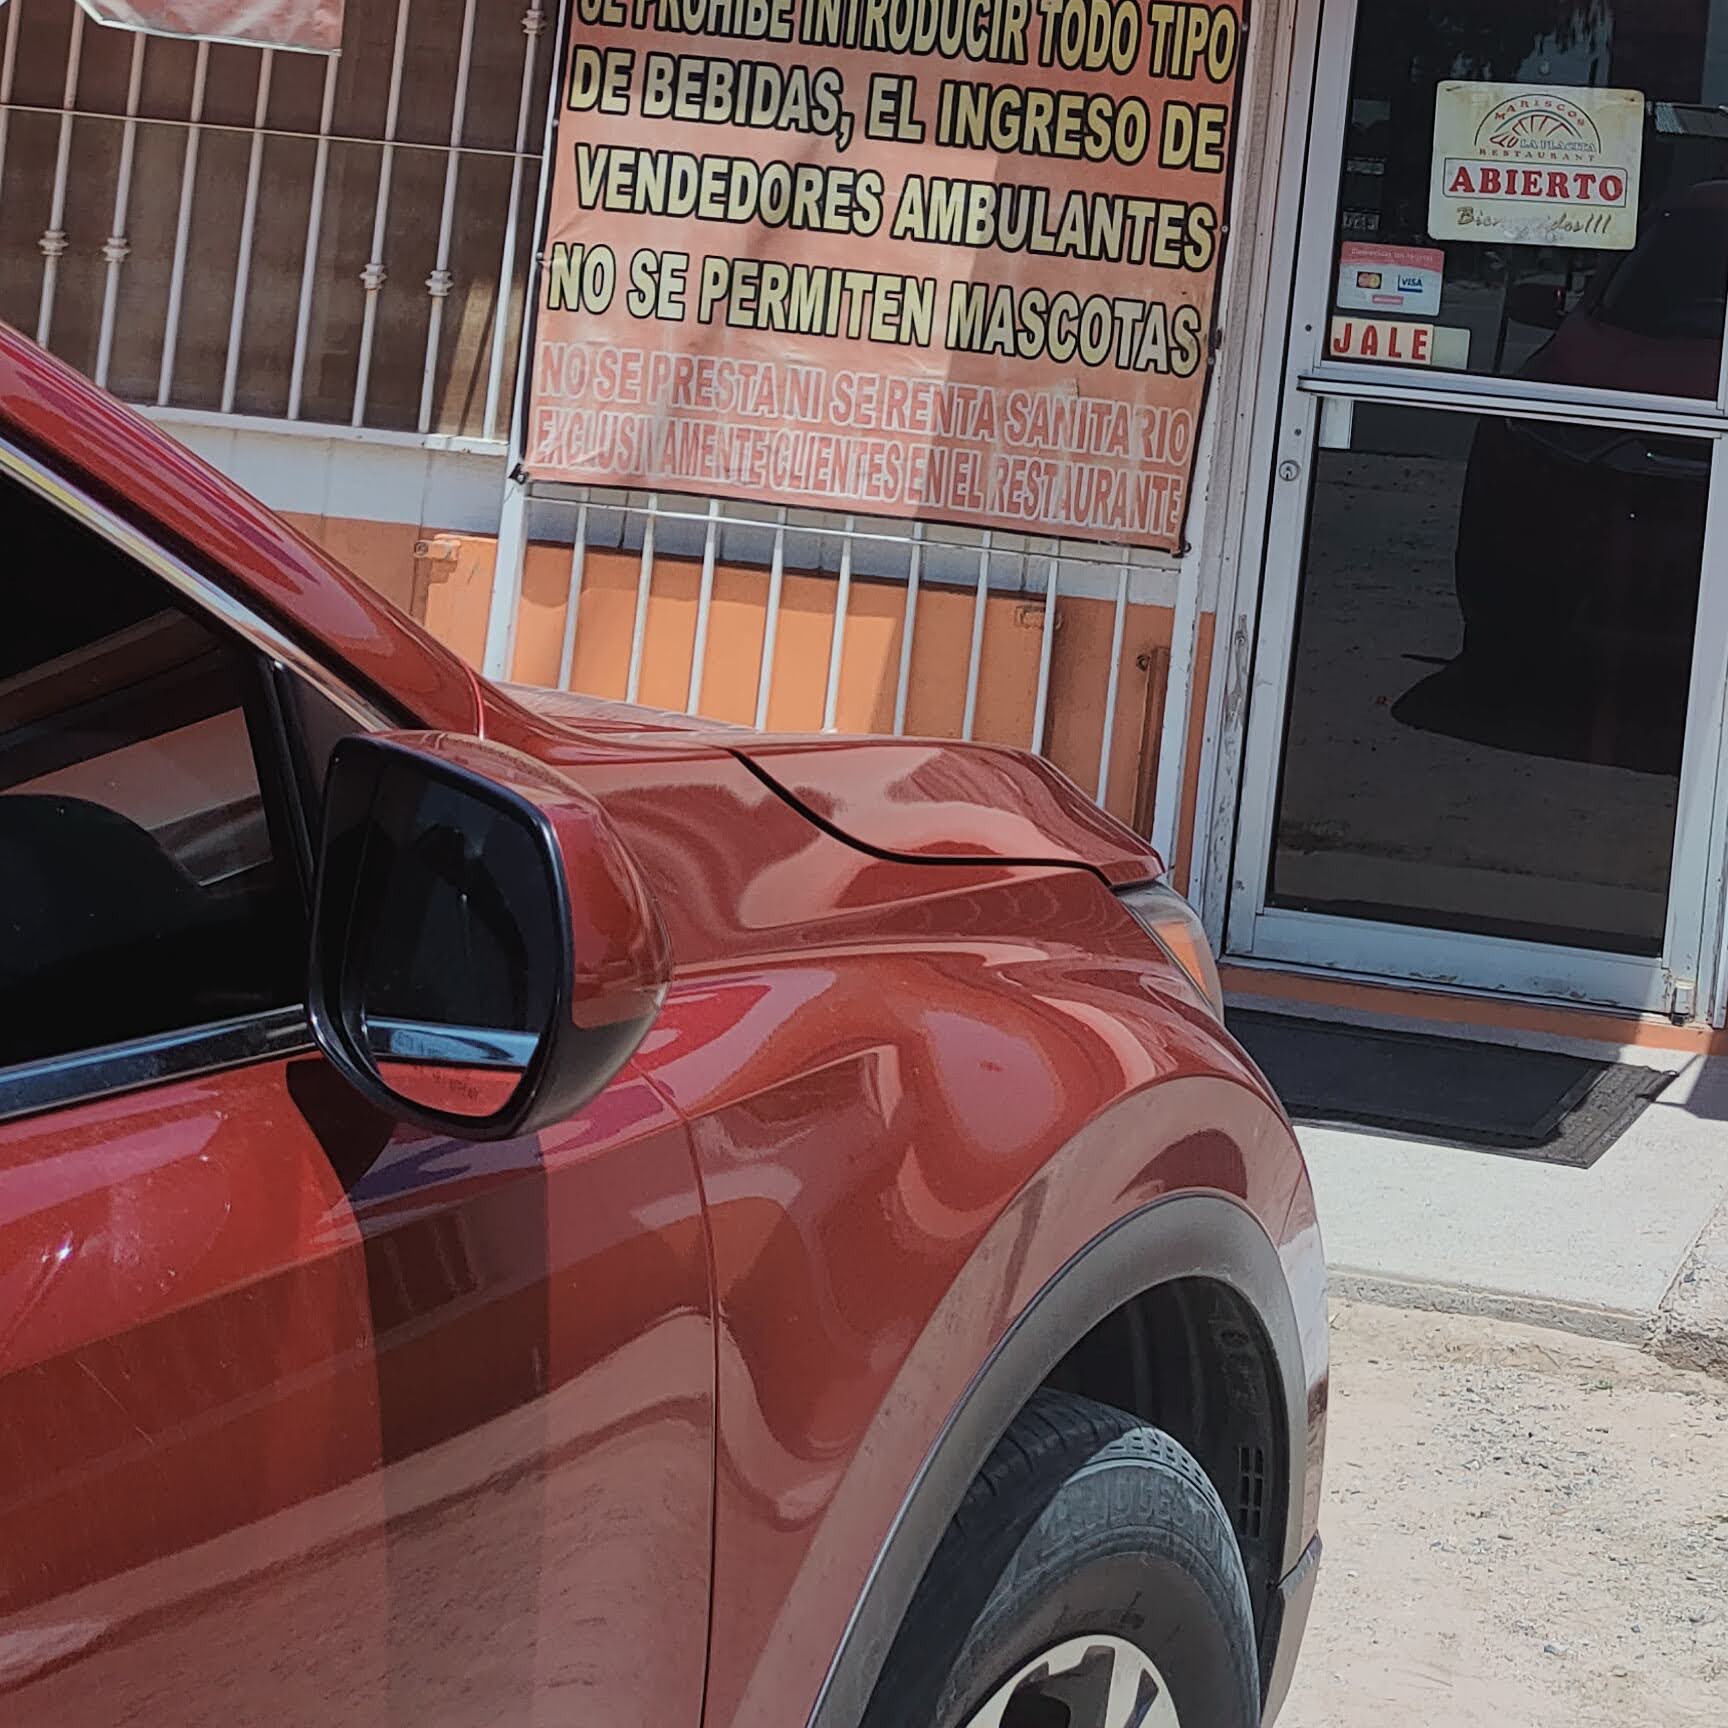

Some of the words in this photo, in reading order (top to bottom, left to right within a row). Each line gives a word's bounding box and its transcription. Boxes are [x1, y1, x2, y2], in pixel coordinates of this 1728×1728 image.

[1149, 3, 1239, 83] TIPO
[566, 46, 634, 116] DE
[641, 54, 855, 151] BEBIDAS,
[864, 73, 924, 142] EL
[936, 81, 1150, 166] INGRESO
[1160, 101, 1228, 173] DE
[1494, 100, 1585, 127] MARISCOS
[1448, 165, 1625, 202] ABIERTO
[1479, 148, 1596, 163] RESTAURANT
[574, 143, 884, 237] VENDEDORES
[891, 175, 1218, 272] AMBULANTES
[546, 243, 618, 316] NO
[626, 248, 691, 323] SE
[698, 255, 938, 348] PERMITEN
[945, 279, 1202, 378] MASCOTAS
[1401, 277, 1424, 288] VISA
[1333, 322, 1429, 361] JALE
[537, 340, 588, 399] NO
[591, 344, 644, 404] SE
[648, 349, 779, 419] PRESTA
[782, 363, 826, 423] NI
[828, 370, 881, 429] SE
[881, 374, 998, 443] RENTA
[1003, 388, 1193, 467] SANITARIO
[768, 426, 905, 505] CLIENTES
[905, 443, 949, 508] EN
[948, 447, 985, 512] EL
[986, 452, 1186, 537] RESTAURANTE
